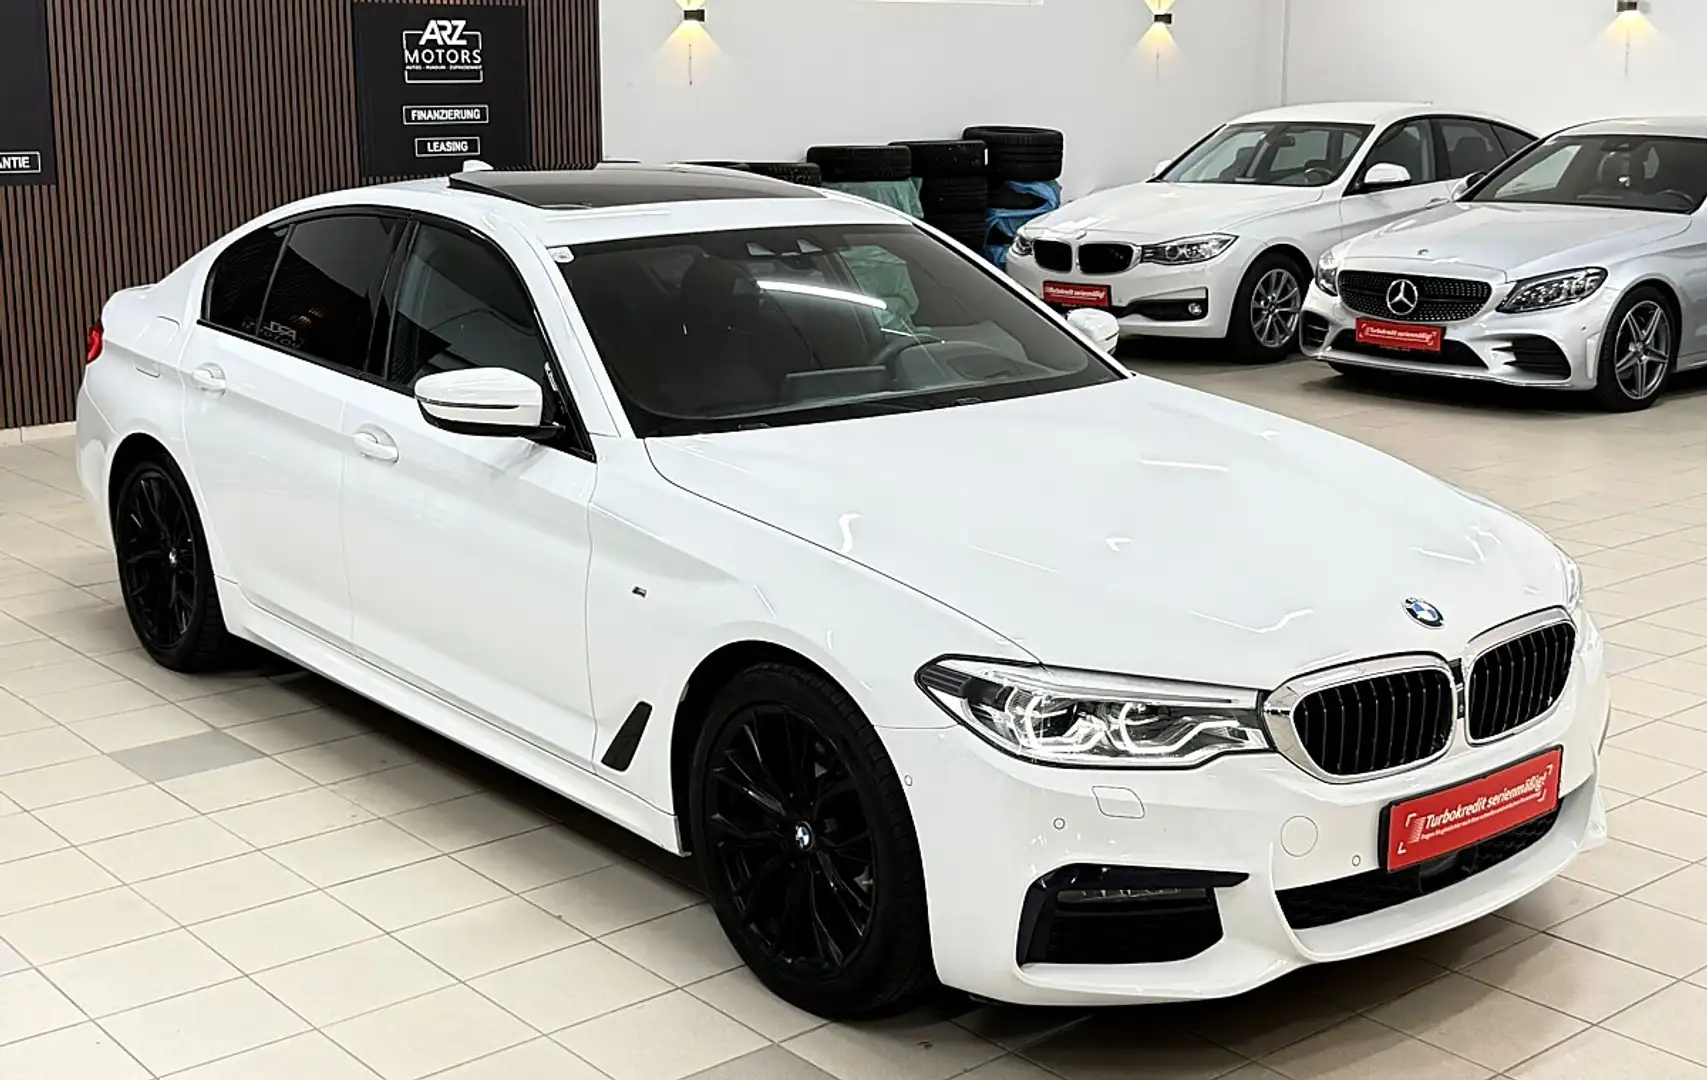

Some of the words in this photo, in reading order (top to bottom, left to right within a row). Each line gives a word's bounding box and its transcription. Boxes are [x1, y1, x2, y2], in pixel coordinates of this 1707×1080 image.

[418, 19, 468, 46] ARZ
[404, 49, 482, 64] MOTORS
[411, 109, 481, 121] FINANZIERUNG
[427, 141, 469, 152] LEASING
[1425, 796, 1487, 829] Turbokredit
[1486, 771, 1547, 808] serienmäßig!
